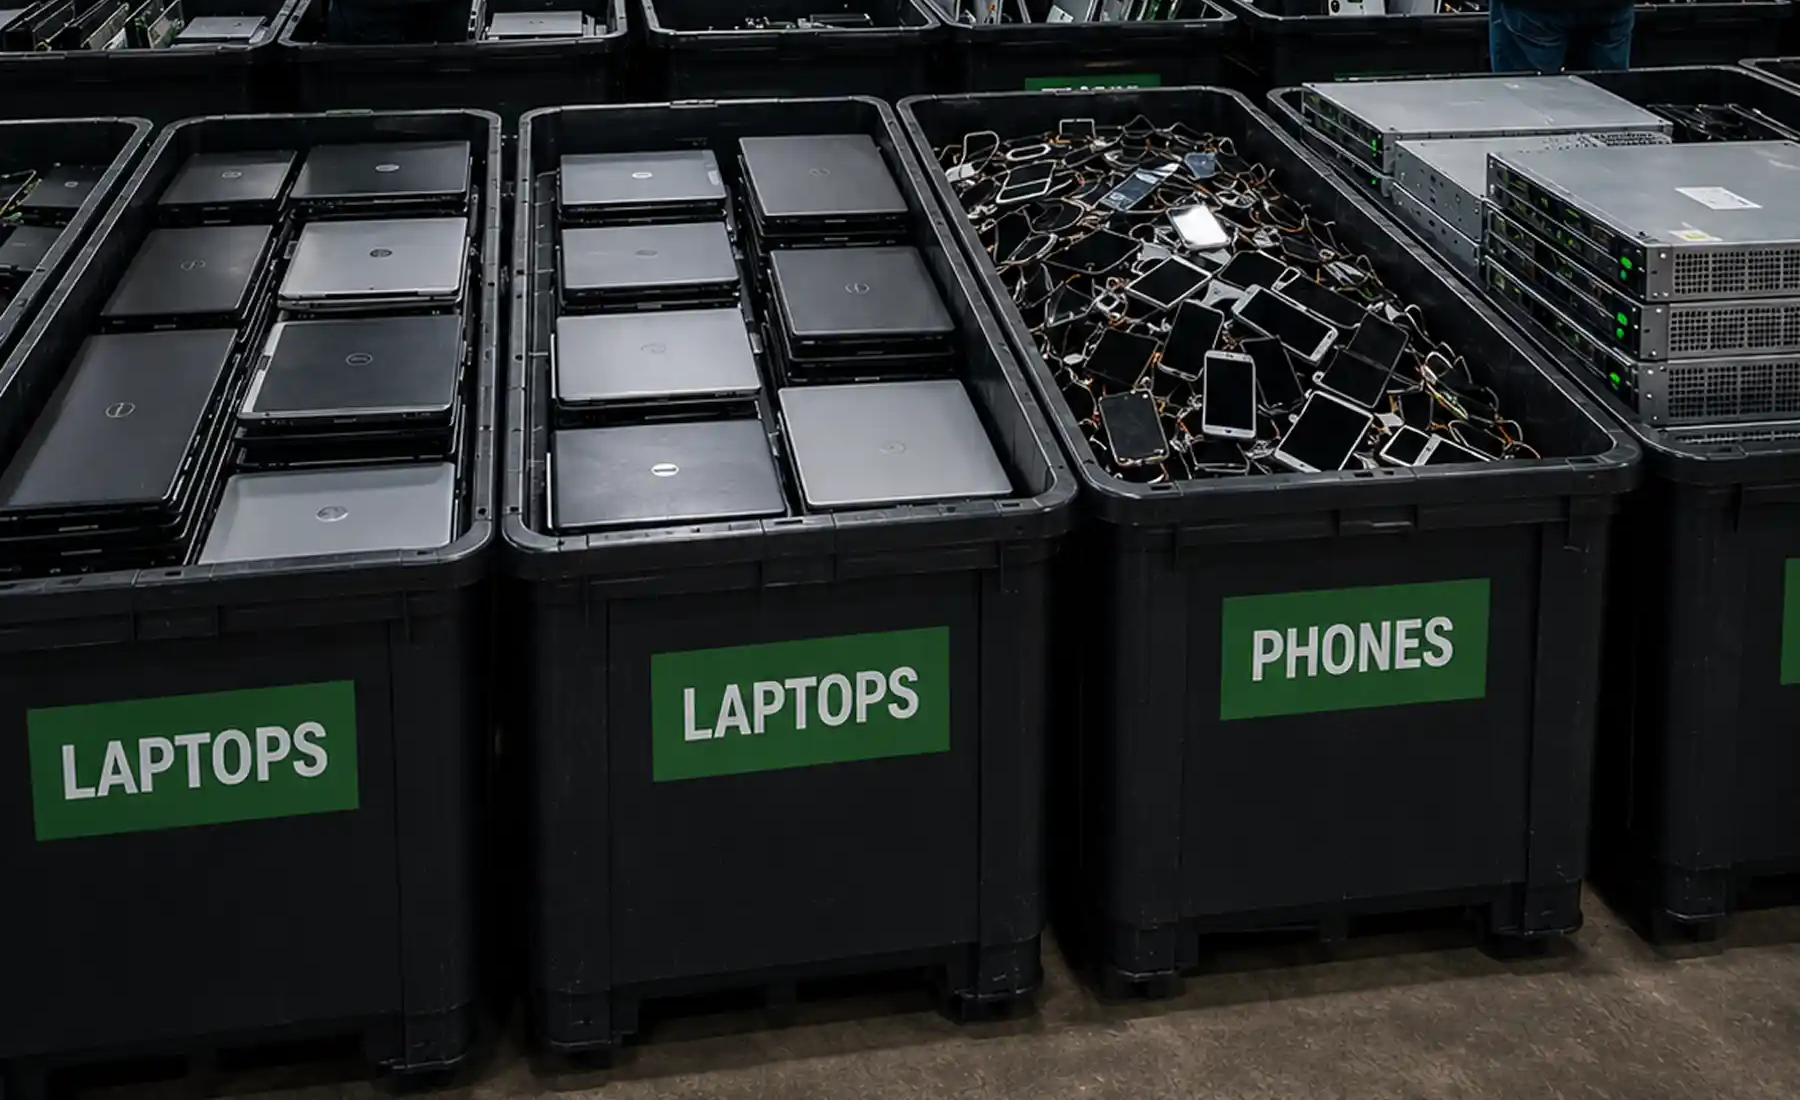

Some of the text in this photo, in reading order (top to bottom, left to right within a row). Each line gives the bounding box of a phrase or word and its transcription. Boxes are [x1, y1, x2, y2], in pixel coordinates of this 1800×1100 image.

[1251, 616, 1454, 682] PHONES
[683, 666, 919, 742] LAPTOPS
[62, 721, 328, 800] LAPTOPS
